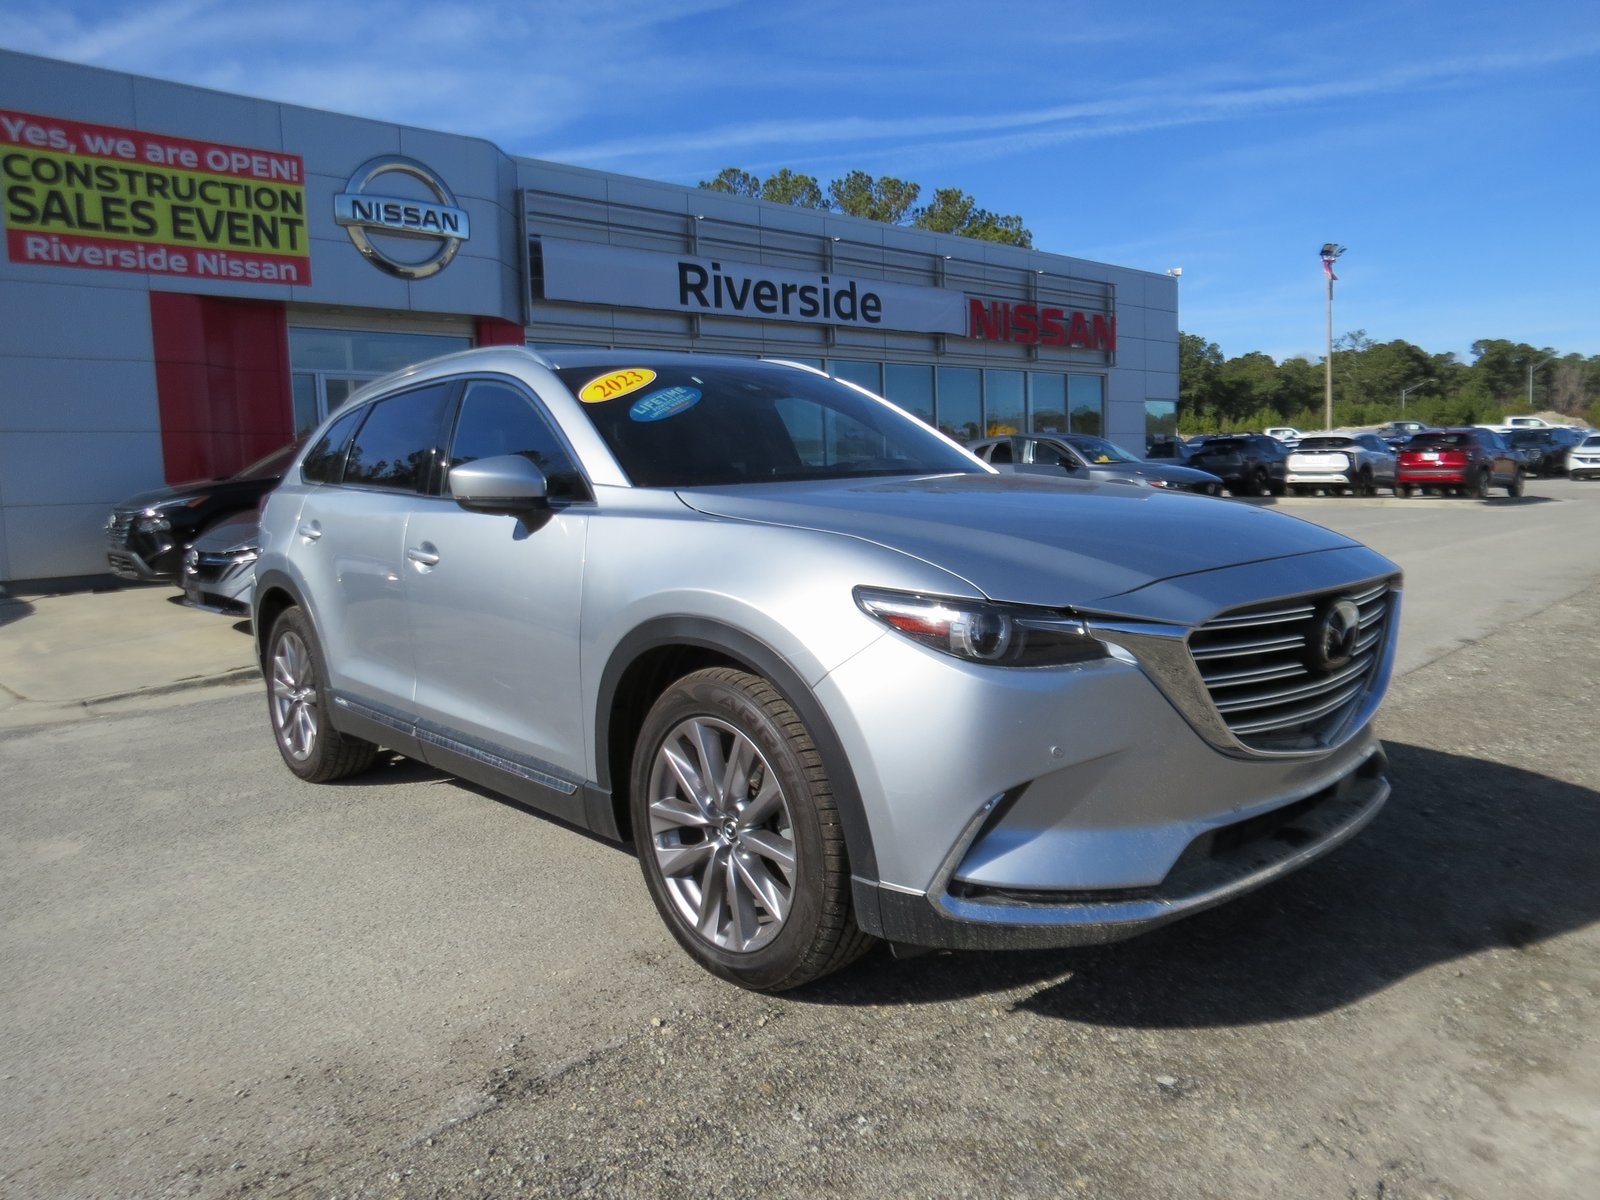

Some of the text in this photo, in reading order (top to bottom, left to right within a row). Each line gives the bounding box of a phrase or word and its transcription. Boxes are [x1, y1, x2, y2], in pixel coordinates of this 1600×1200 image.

[1, 117, 298, 182] Yes, we are OPEN!
[3, 153, 303, 215] CONSTRUCTION
[7, 185, 304, 251] SALES EVENT
[351, 199, 460, 233] NISSAN
[25, 236, 298, 282] Riverside Nissan
[677, 261, 883, 324] Riverside
[968, 297, 1117, 353] NISSAN
[594, 371, 644, 397] 2023
[633, 387, 686, 414] LIFETIME
